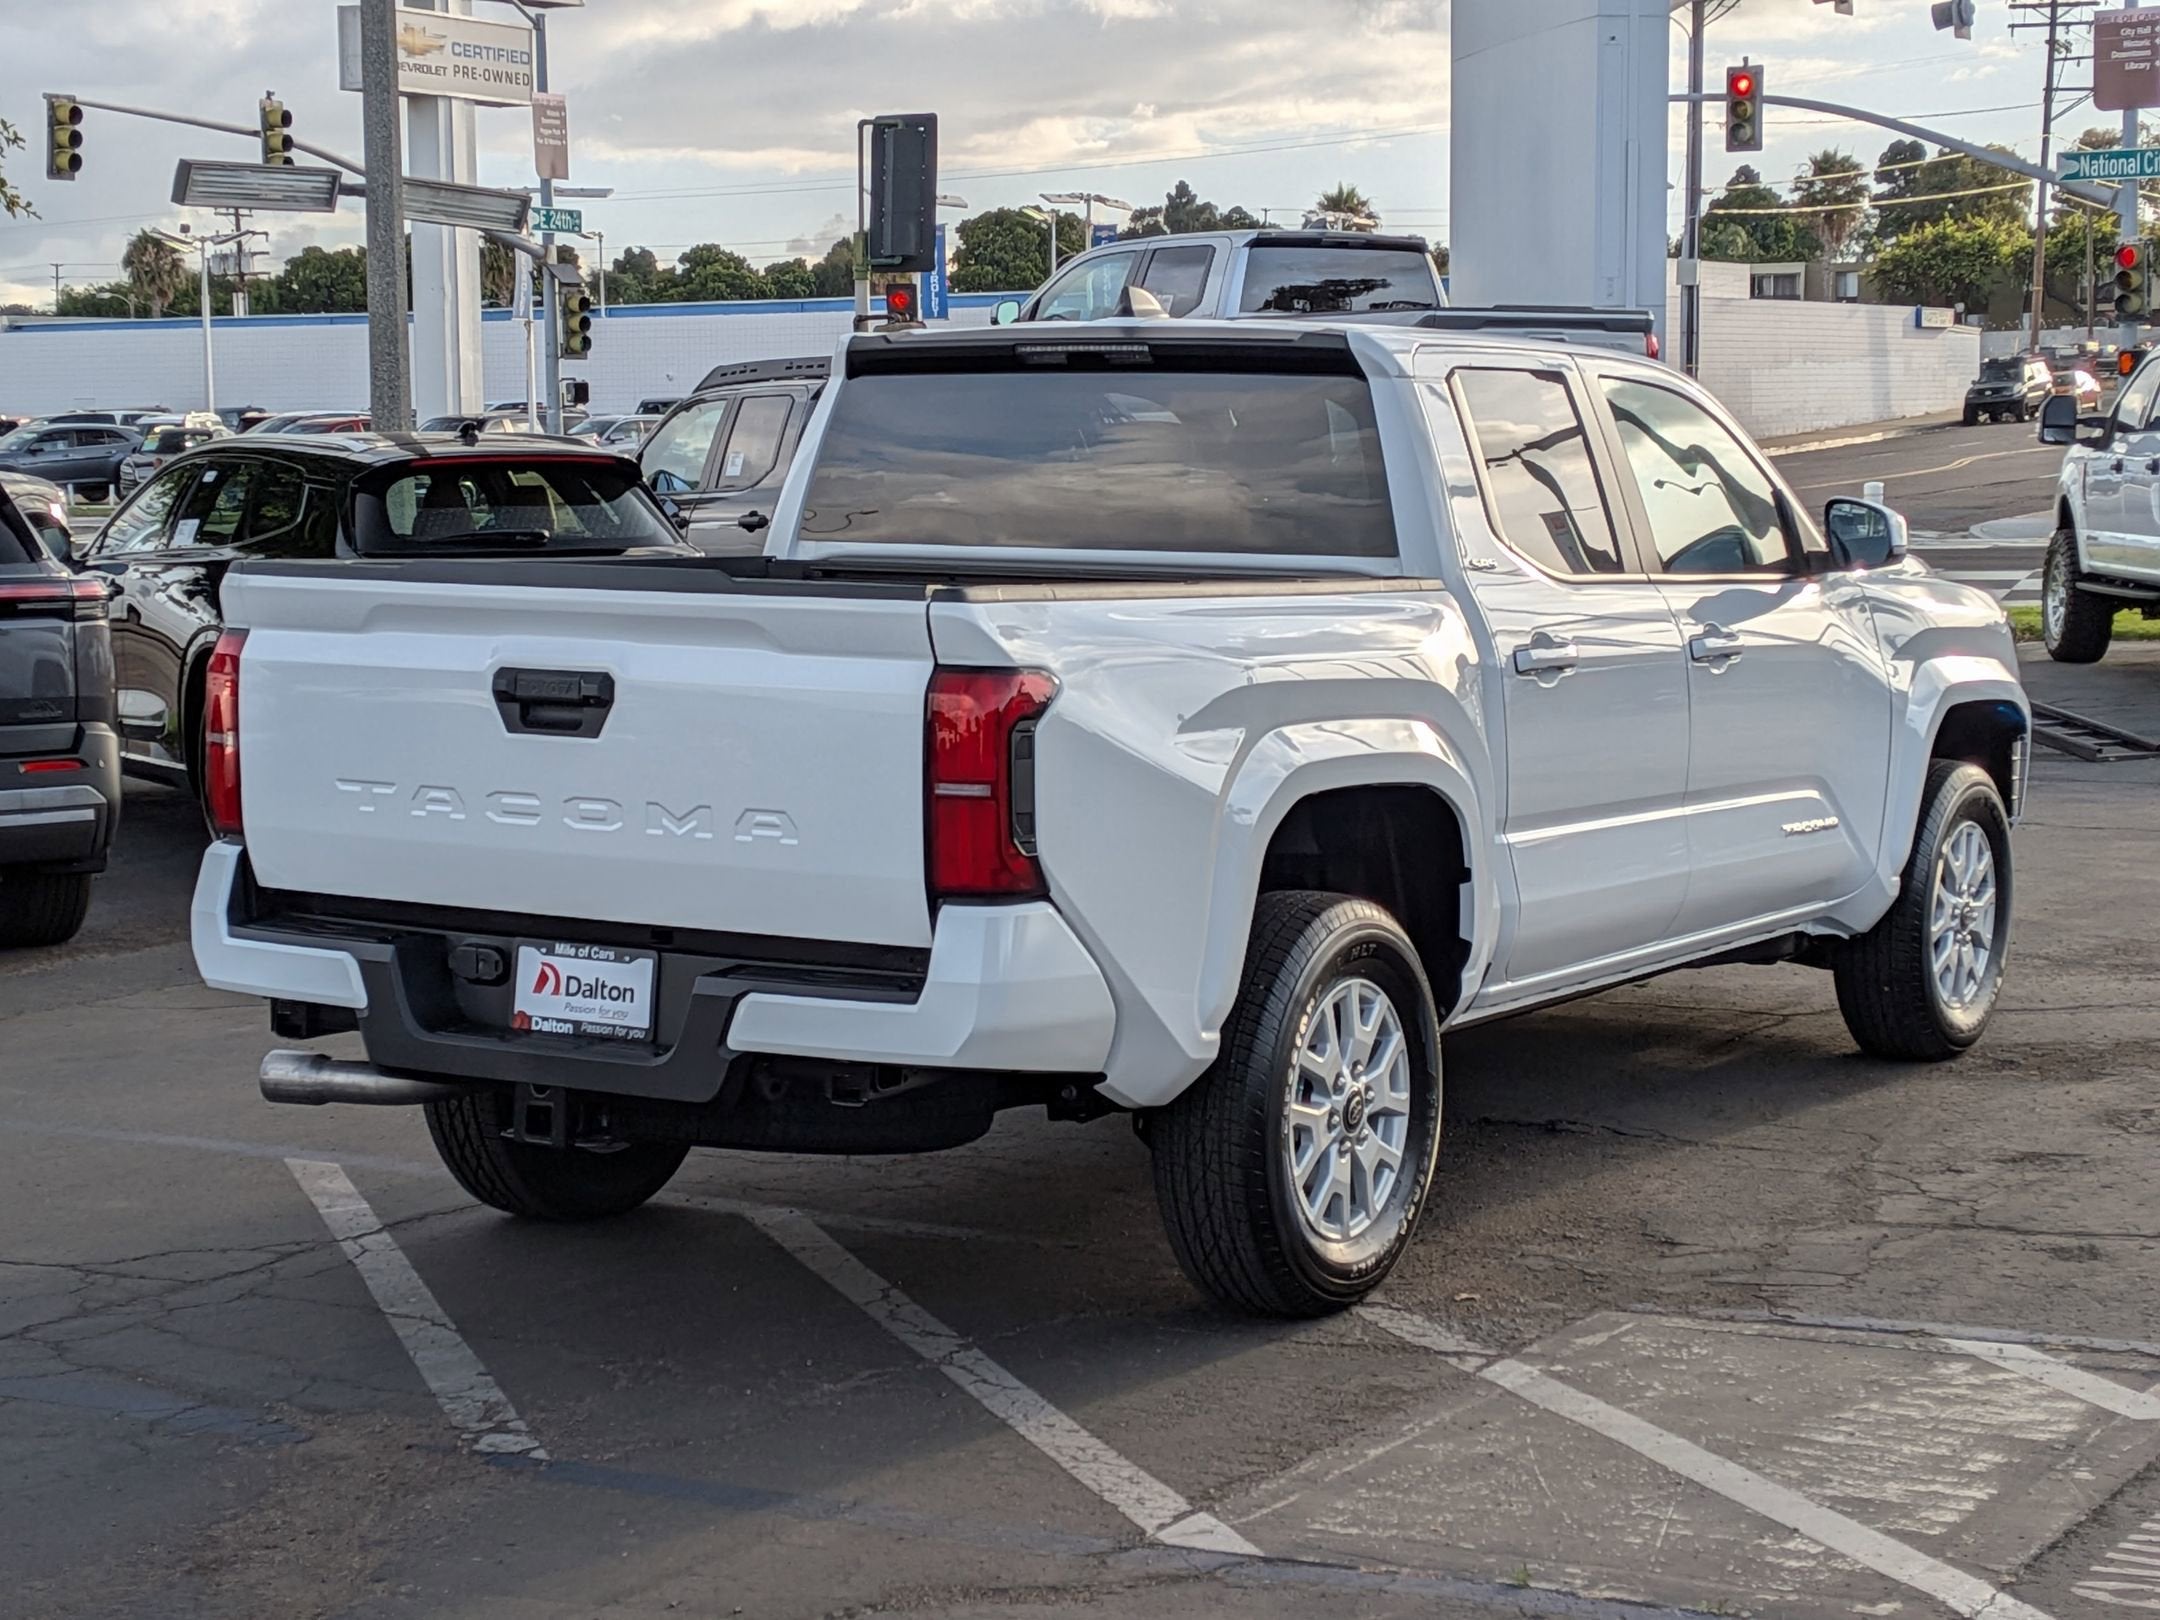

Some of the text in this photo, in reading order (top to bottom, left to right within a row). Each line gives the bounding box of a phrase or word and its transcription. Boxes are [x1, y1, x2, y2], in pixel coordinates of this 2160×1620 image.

[2120, 25, 2152, 37] City Hall
[451, 41, 531, 65] CERTIFIED
[453, 64, 531, 87] PRE-OWNED
[2124, 61, 2152, 71] Library
[2080, 151, 2141, 177] National
[540, 209, 549, 229] E
[549, 210, 573, 231] 24th
[335, 777, 799, 845] TACOMA
[554, 943, 615, 960] Mile of Cars
[565, 975, 635, 1004] Dalton
[563, 1002, 629, 1020] Passion for you
[531, 1016, 645, 1040] Dalton Passion for you
